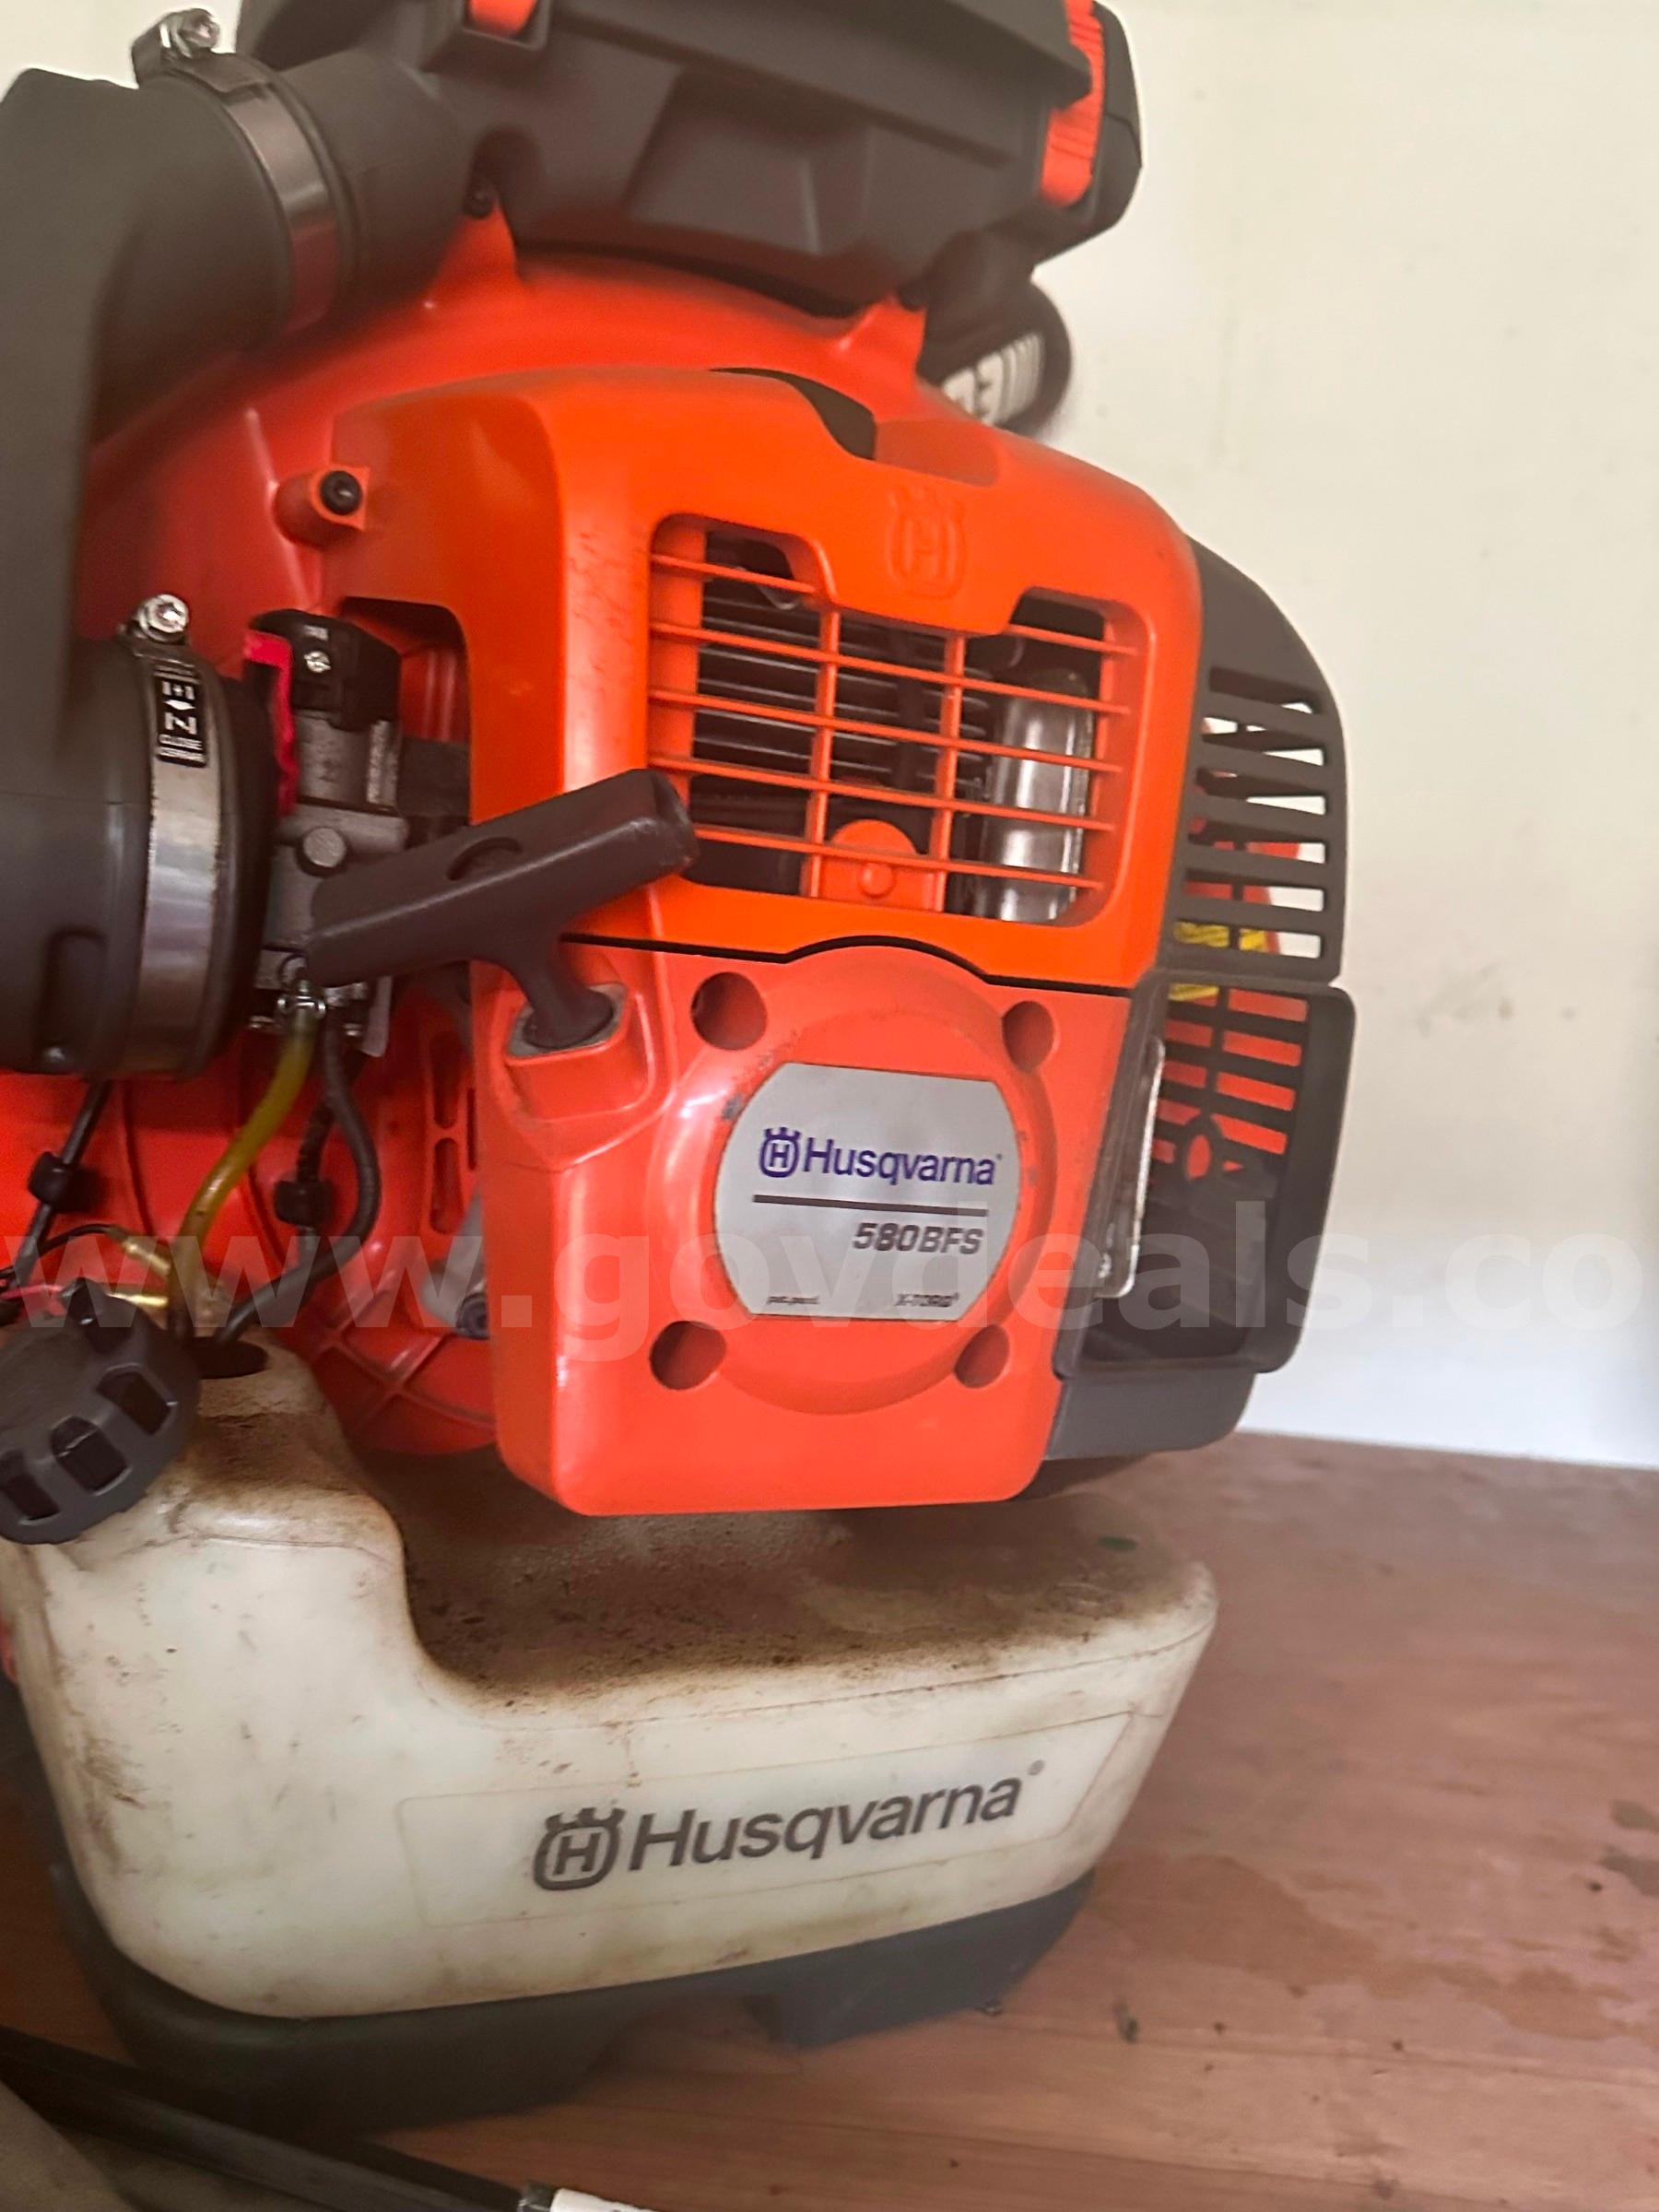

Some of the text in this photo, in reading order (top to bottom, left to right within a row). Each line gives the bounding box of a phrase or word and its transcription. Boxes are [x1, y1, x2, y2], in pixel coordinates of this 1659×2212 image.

[803, 1136, 995, 1186] Husqvarna
[853, 1222, 984, 1254] 580BFS
[627, 1776, 1023, 1872] Husqvarna
